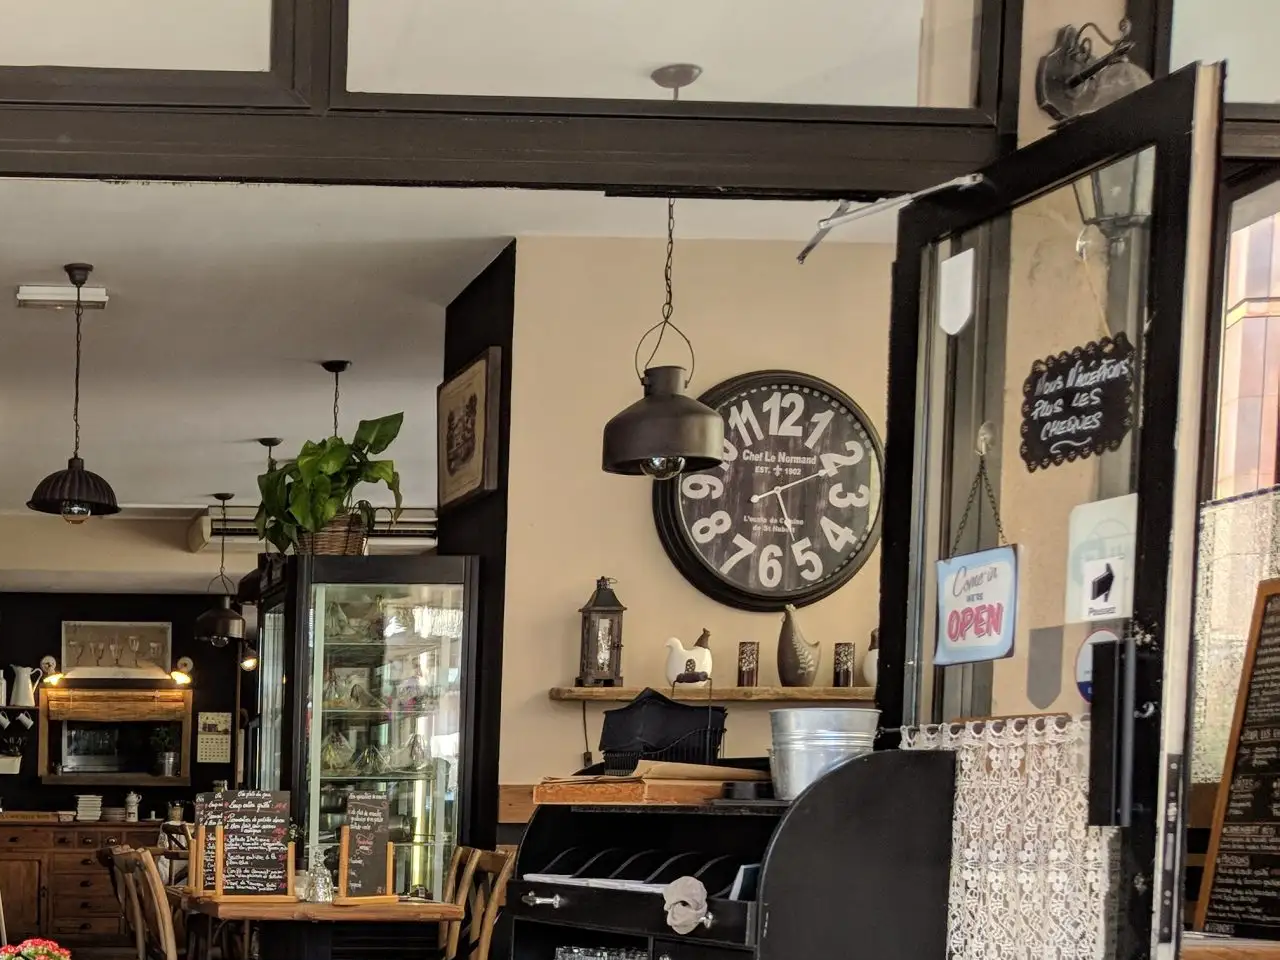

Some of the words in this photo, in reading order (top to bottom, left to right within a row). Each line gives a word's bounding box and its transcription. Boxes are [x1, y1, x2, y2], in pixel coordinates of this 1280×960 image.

[762, 391, 805, 437] 12
[1071, 387, 1103, 407] LES
[728, 400, 764, 447] 11
[804, 409, 835, 449] 1
[742, 449, 765, 461] Chef
[765, 451, 776, 463] Le
[777, 451, 817, 465] Normand
[820, 440, 864, 477] 2
[682, 474, 724, 499] 9
[828, 482, 870, 508] 3
[691, 510, 732, 543] 8
[819, 515, 858, 552] 4
[720, 533, 757, 575] 7
[758, 544, 783, 588] 6
[790, 537, 823, 581] 5
[947, 602, 1004, 642] OPEN
